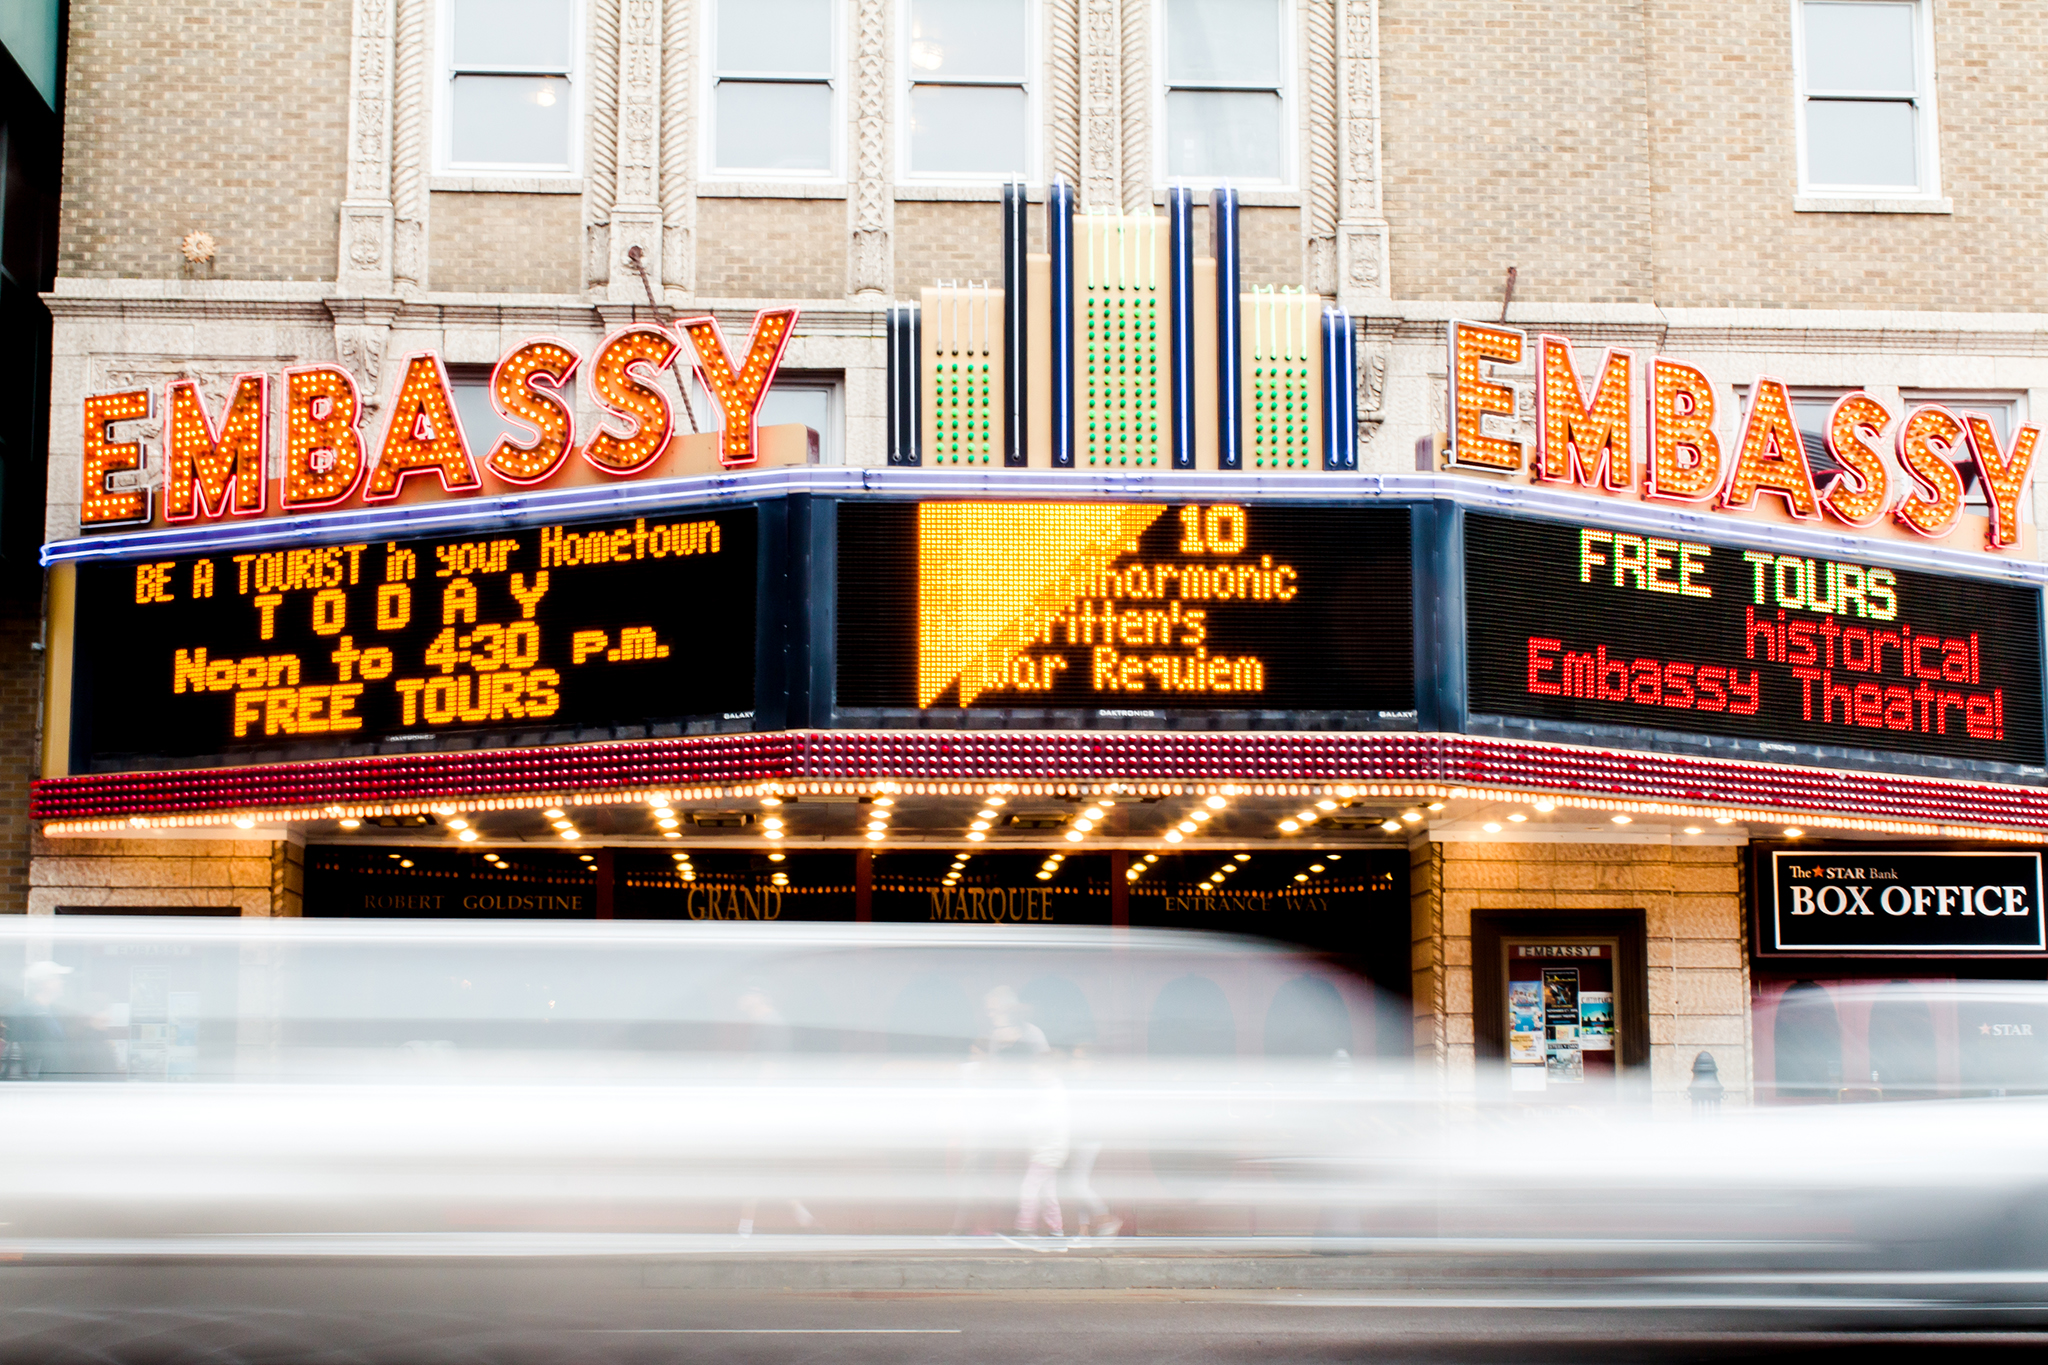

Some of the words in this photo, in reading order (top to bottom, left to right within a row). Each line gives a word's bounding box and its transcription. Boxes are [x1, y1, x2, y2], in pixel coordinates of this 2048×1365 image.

[80, 306, 800, 526] EMBASSY
[1447, 318, 2047, 550] EMBASSY
[1180, 503, 1247, 553] 10
[136, 562, 176, 603] BE
[193, 559, 214, 598] A
[232, 544, 368, 594] TOURIST
[386, 541, 416, 581] in
[436, 531, 521, 577] your
[540, 517, 721, 569] Hometown
[1579, 527, 1713, 599] FREE
[1742, 550, 1898, 621] TOURS
[174, 647, 301, 693] Noon
[331, 635, 393, 682] to
[425, 620, 540, 673] 4:30
[1093, 644, 1264, 692] Requiem
[1745, 604, 1980, 685] historical
[1528, 636, 1760, 716] Embassy
[234, 682, 364, 736] FREE
[396, 668, 560, 726] TOURS
[1378, 710, 1414, 718] GALAXY
[1789, 865, 1812, 878] The
[1825, 867, 1866, 880] STAR
[1869, 867, 1899, 880] Bank
[364, 894, 445, 910] ROBERT
[463, 894, 583, 910] GOLDSTINE
[687, 887, 782, 921] GRAND
[929, 887, 1055, 923] MARQUEE
[1165, 896, 1271, 912] ENTRANCE
[1285, 896, 1330, 912] WAY
[1789, 885, 1875, 916] BOX
[1880, 884, 2029, 916] OFFICE
[1525, 946, 1593, 957] EMBASSY
[1992, 1023, 2034, 1036] STAR
